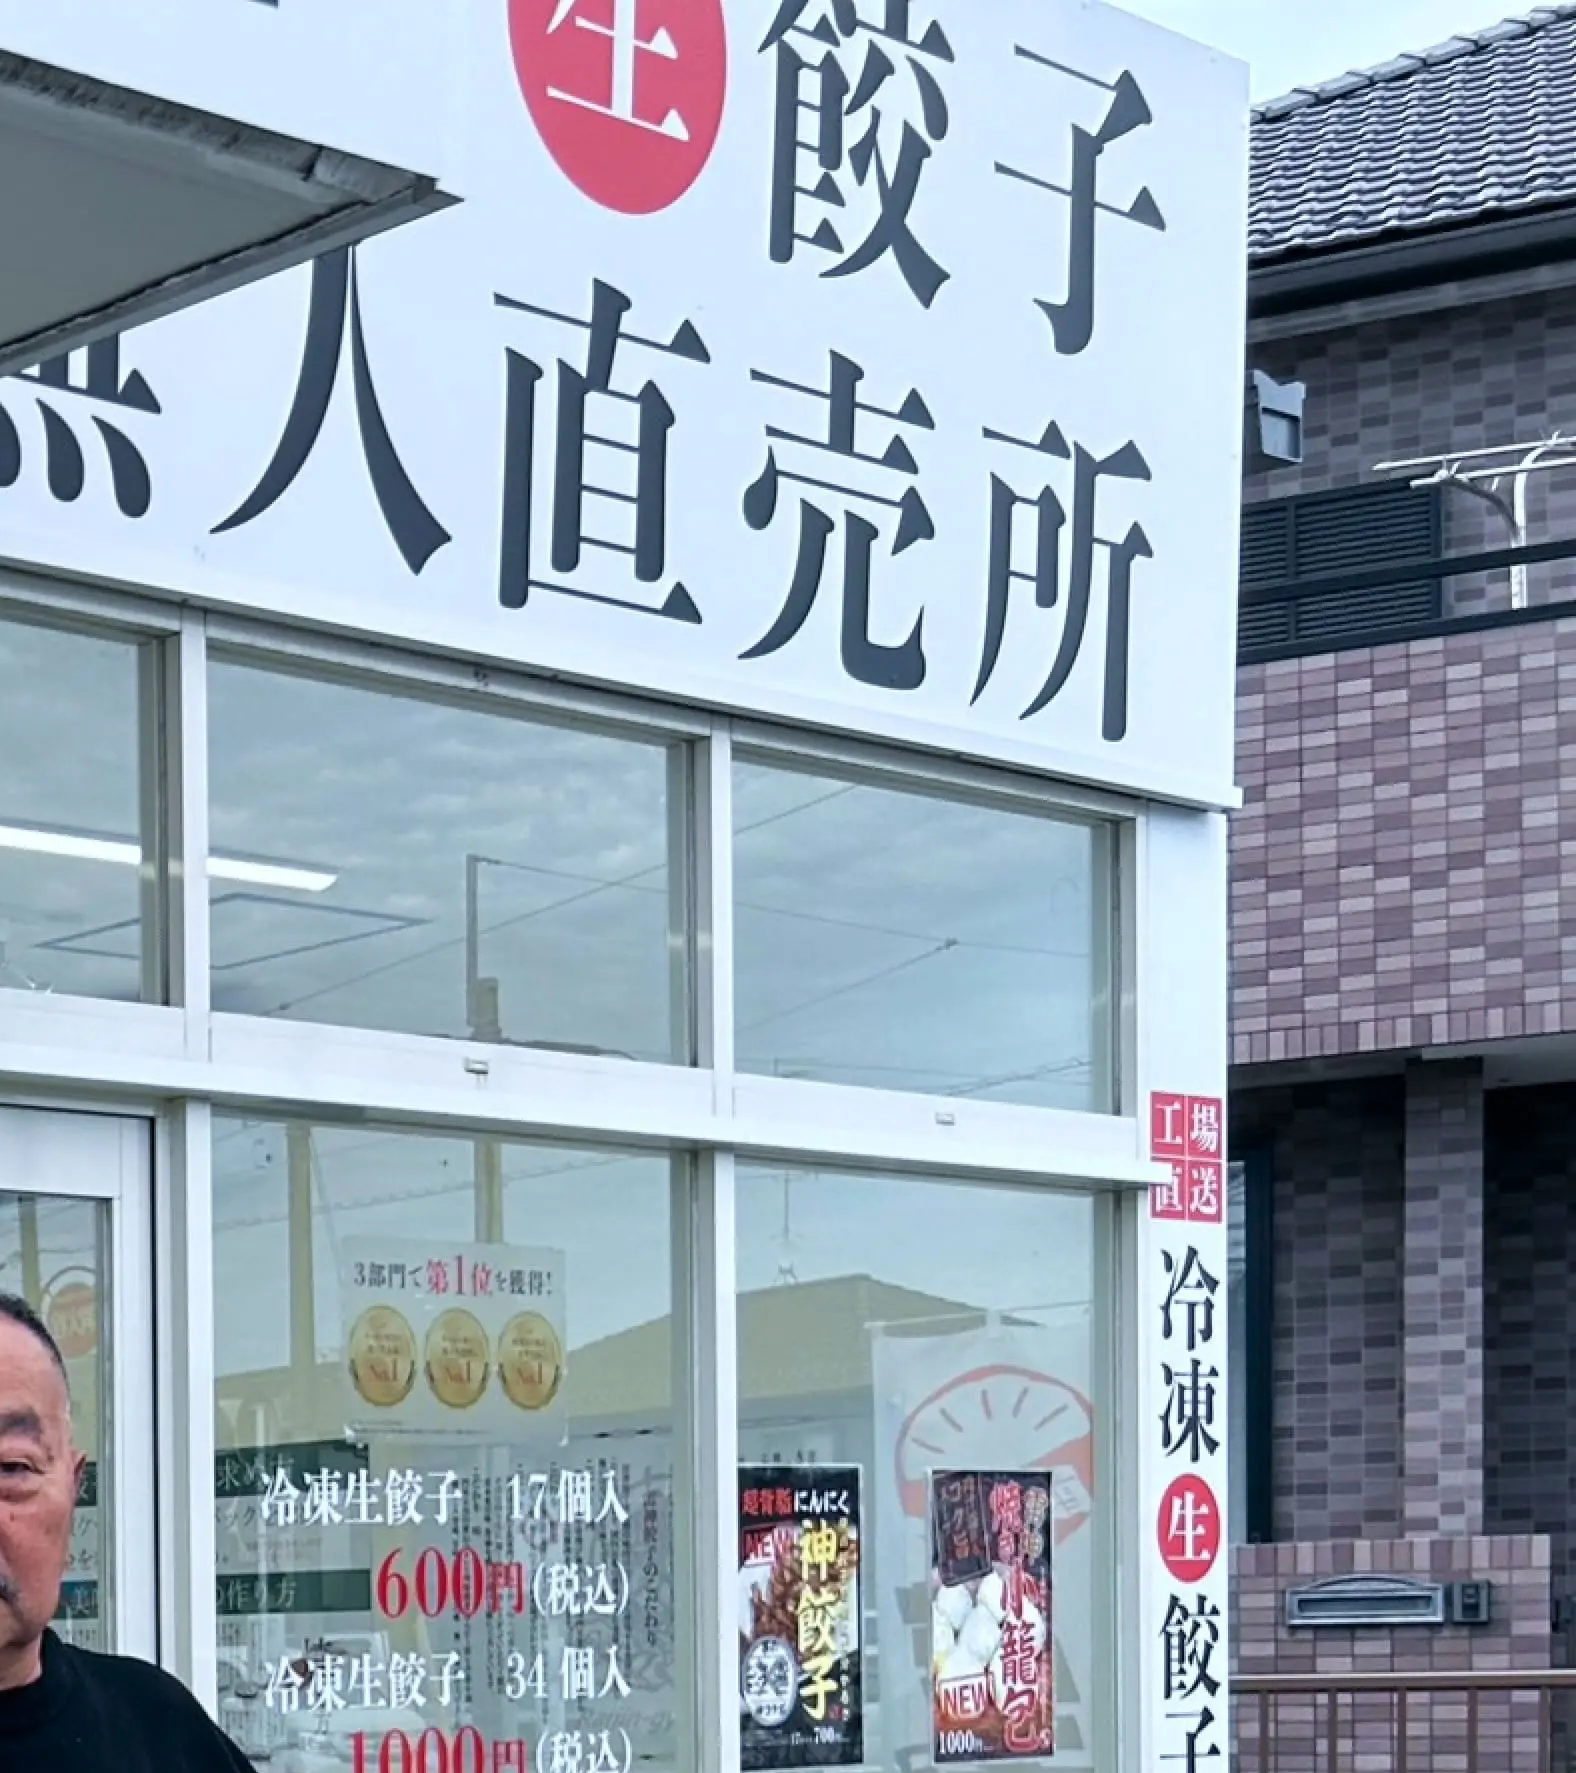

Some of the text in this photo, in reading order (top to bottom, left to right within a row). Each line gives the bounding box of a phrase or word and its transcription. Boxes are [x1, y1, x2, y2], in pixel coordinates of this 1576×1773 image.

[1155, 1102, 1218, 1156] 工場
[353, 1255, 553, 1296] 3部門で第1位を獲得!
[260, 1466, 462, 1526] 冷凍生餃子
[377, 1545, 629, 1619] 600円 (税込)
[798, 1518, 838, 1722] 神餃子
[264, 1651, 465, 1713] 冷凍生餃子
[941, 1680, 987, 1718] NEW
